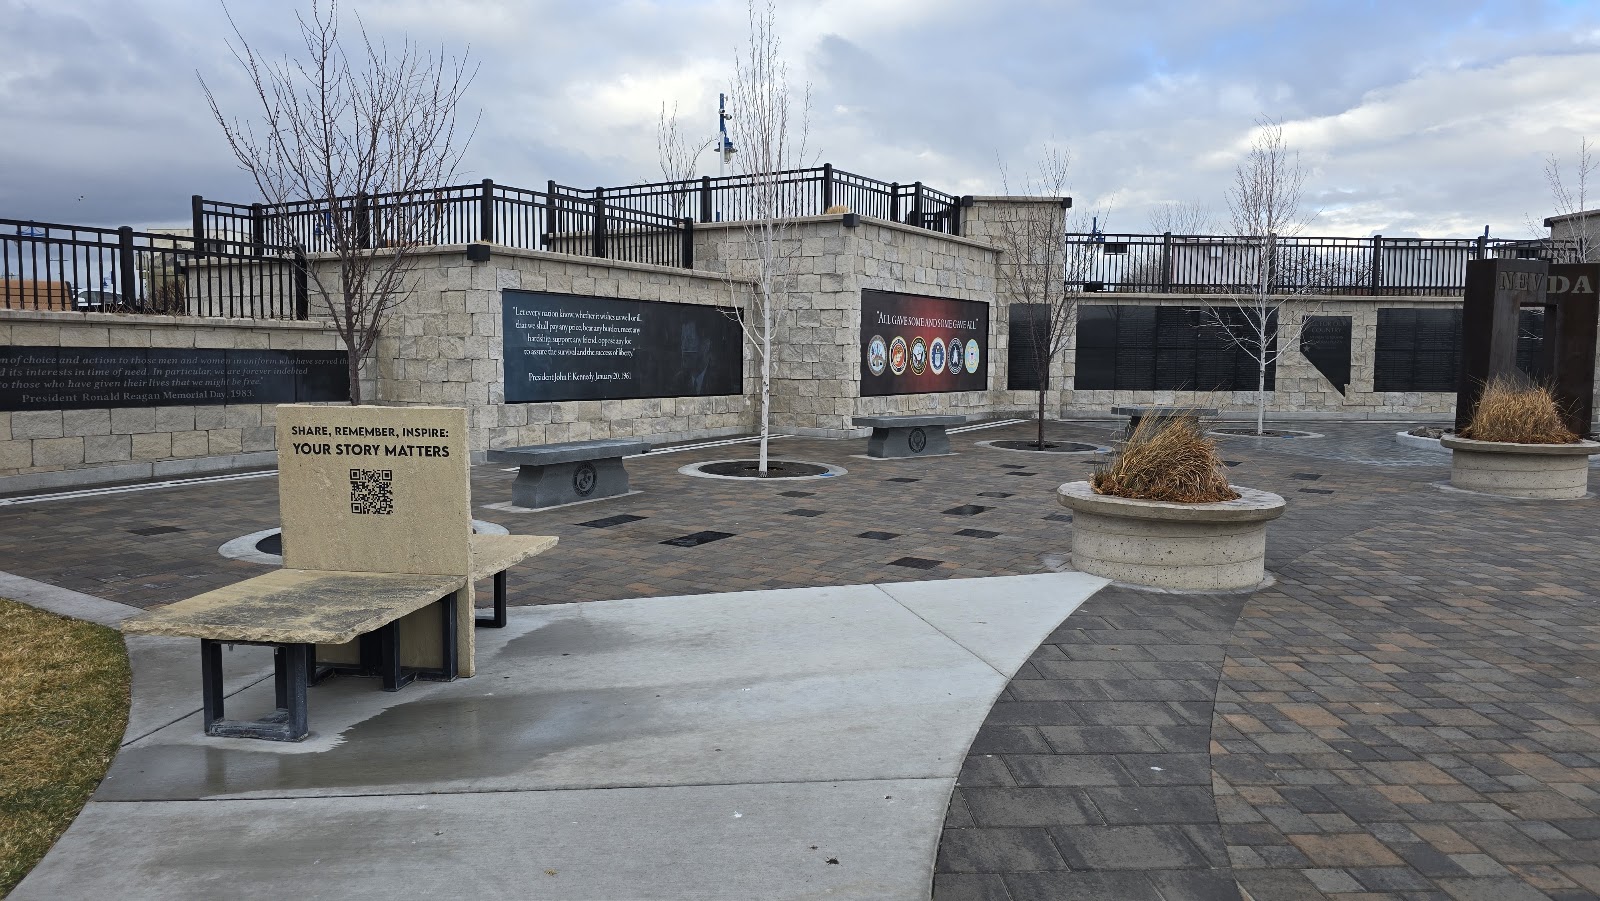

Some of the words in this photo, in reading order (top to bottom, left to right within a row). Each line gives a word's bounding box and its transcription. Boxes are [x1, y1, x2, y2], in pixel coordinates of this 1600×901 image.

[526, 309, 540, 320] every
[541, 309, 559, 318] nation
[575, 310, 595, 320] whether
[620, 312, 631, 322] well
[891, 314, 908, 326] GAVE
[908, 316, 925, 327] SOME
[924, 317, 938, 328] AND
[937, 318, 953, 329] SOME
[952, 319, 967, 329] GAVE
[515, 319, 527, 329] that
[536, 320, 549, 330] shall
[549, 323, 559, 333] pay
[559, 323, 568, 334] any
[582, 322, 594, 332] bear
[593, 326, 603, 335] any
[632, 328, 641, 336] any
[552, 336, 573, 346] support
[572, 337, 582, 346] any
[598, 338, 616, 347] oppose
[615, 339, 624, 347] any
[547, 346, 557, 356] the
[557, 346, 577, 356] survival
[576, 347, 587, 356] and
[586, 347, 595, 356] the
[612, 347, 619, 356] of
[10, 355, 23, 366] of
[23, 355, 57, 364] choice
[59, 355, 79, 364] and
[82, 356, 117, 365] action
[119, 356, 129, 364] to
[130, 356, 157, 365] those
[180, 356, 198, 365] and
[233, 357, 242, 365] in
[242, 356, 277, 367] uniform
[279, 356, 296, 365] who
[296, 357, 314, 365] have
[314, 357, 338, 365] served
[9, 368, 23, 377] its
[26, 368, 73, 376] interests
[75, 368, 85, 376] in
[87, 368, 110, 376] time
[112, 367, 124, 377] of
[152, 367, 162, 376] In
[241, 367, 273, 377] forever
[273, 367, 308, 375] indebted
[528, 371, 554, 382] President
[553, 371, 567, 383] John
[595, 371, 613, 383] January
[621, 371, 632, 380] 1961
[11, 380, 41, 389] those
[44, 379, 65, 388] who
[67, 379, 92, 388] have
[93, 379, 121, 389] given
[123, 379, 147, 387] their
[148, 378, 170, 387] lives
[171, 378, 191, 386] that
[204, 378, 230, 387] might
[231, 377, 241, 386] be
[22, 394, 78, 402] President
[82, 392, 120, 401] Ronald
[123, 392, 160, 402] Reagan
[163, 390, 207, 399] Memorial
[230, 389, 255, 397] 1983.
[291, 425, 332, 437] SHARE,
[334, 426, 400, 438] REMEMBER,
[402, 427, 449, 438] INSPIRE:
[292, 442, 331, 455] YOUR
[335, 443, 380, 456] STORY
[384, 444, 450, 458] MATTERS
